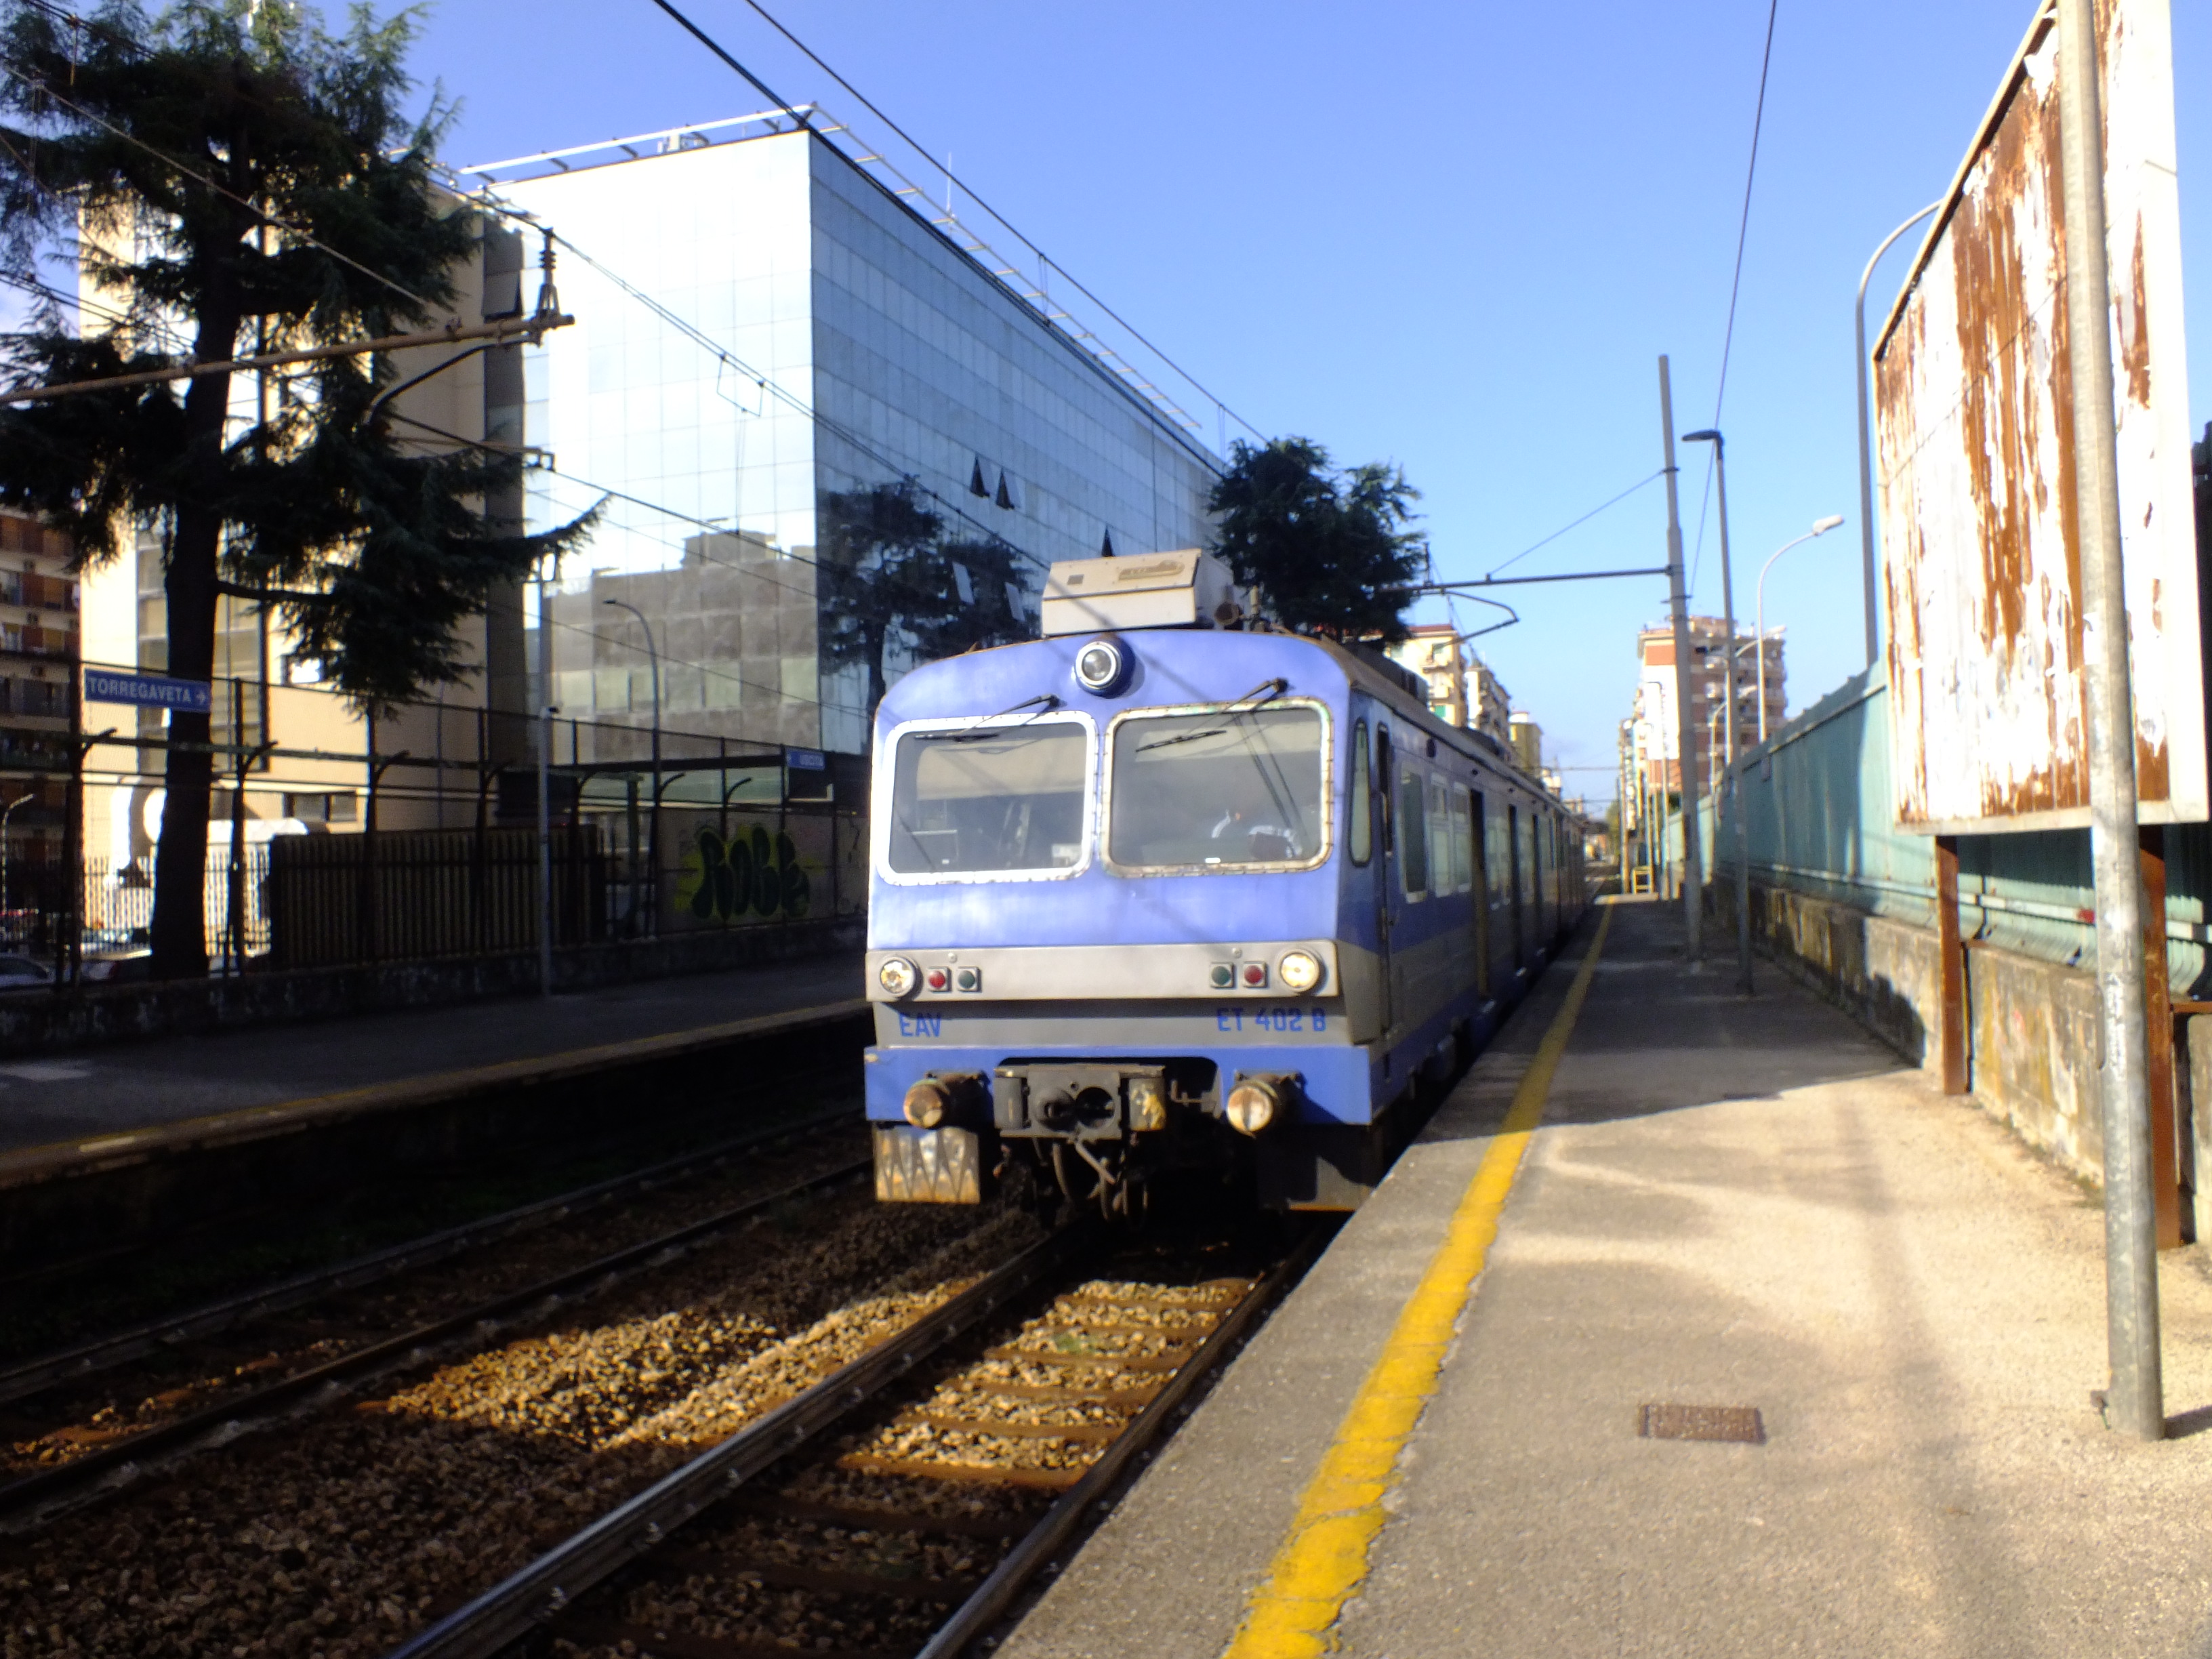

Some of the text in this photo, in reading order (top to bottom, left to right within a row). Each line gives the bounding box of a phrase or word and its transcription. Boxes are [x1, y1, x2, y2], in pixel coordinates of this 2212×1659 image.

[87, 678, 191, 702] TORREGAVETA
[899, 1012, 941, 1037] EAV
[1217, 1008, 1326, 1031] ET 402 B
